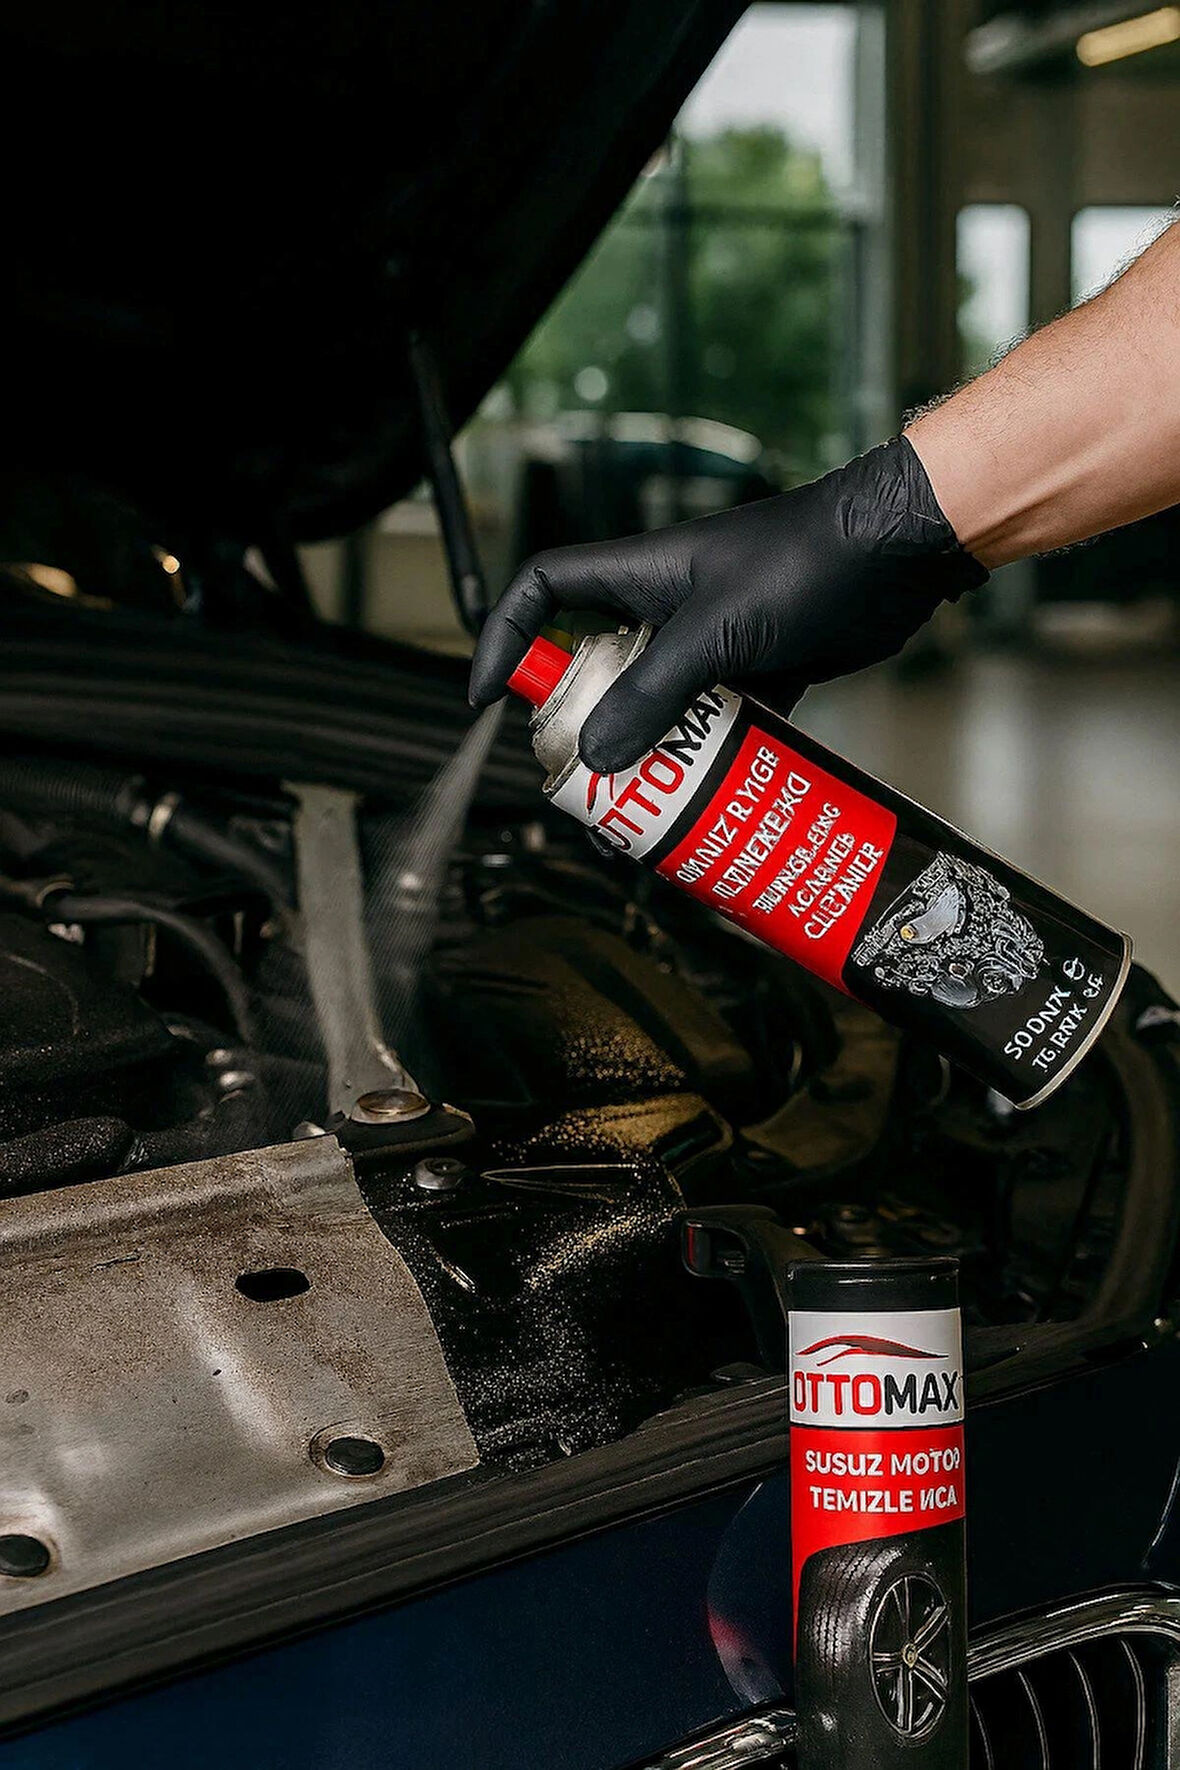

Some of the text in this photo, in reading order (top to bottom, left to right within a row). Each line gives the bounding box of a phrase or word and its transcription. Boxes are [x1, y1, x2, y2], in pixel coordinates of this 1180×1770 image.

[793, 1371, 959, 1415] OTTOMAX
[805, 1450, 884, 1476] SUSUZ
[809, 1486, 914, 1512] TEMIZLE
